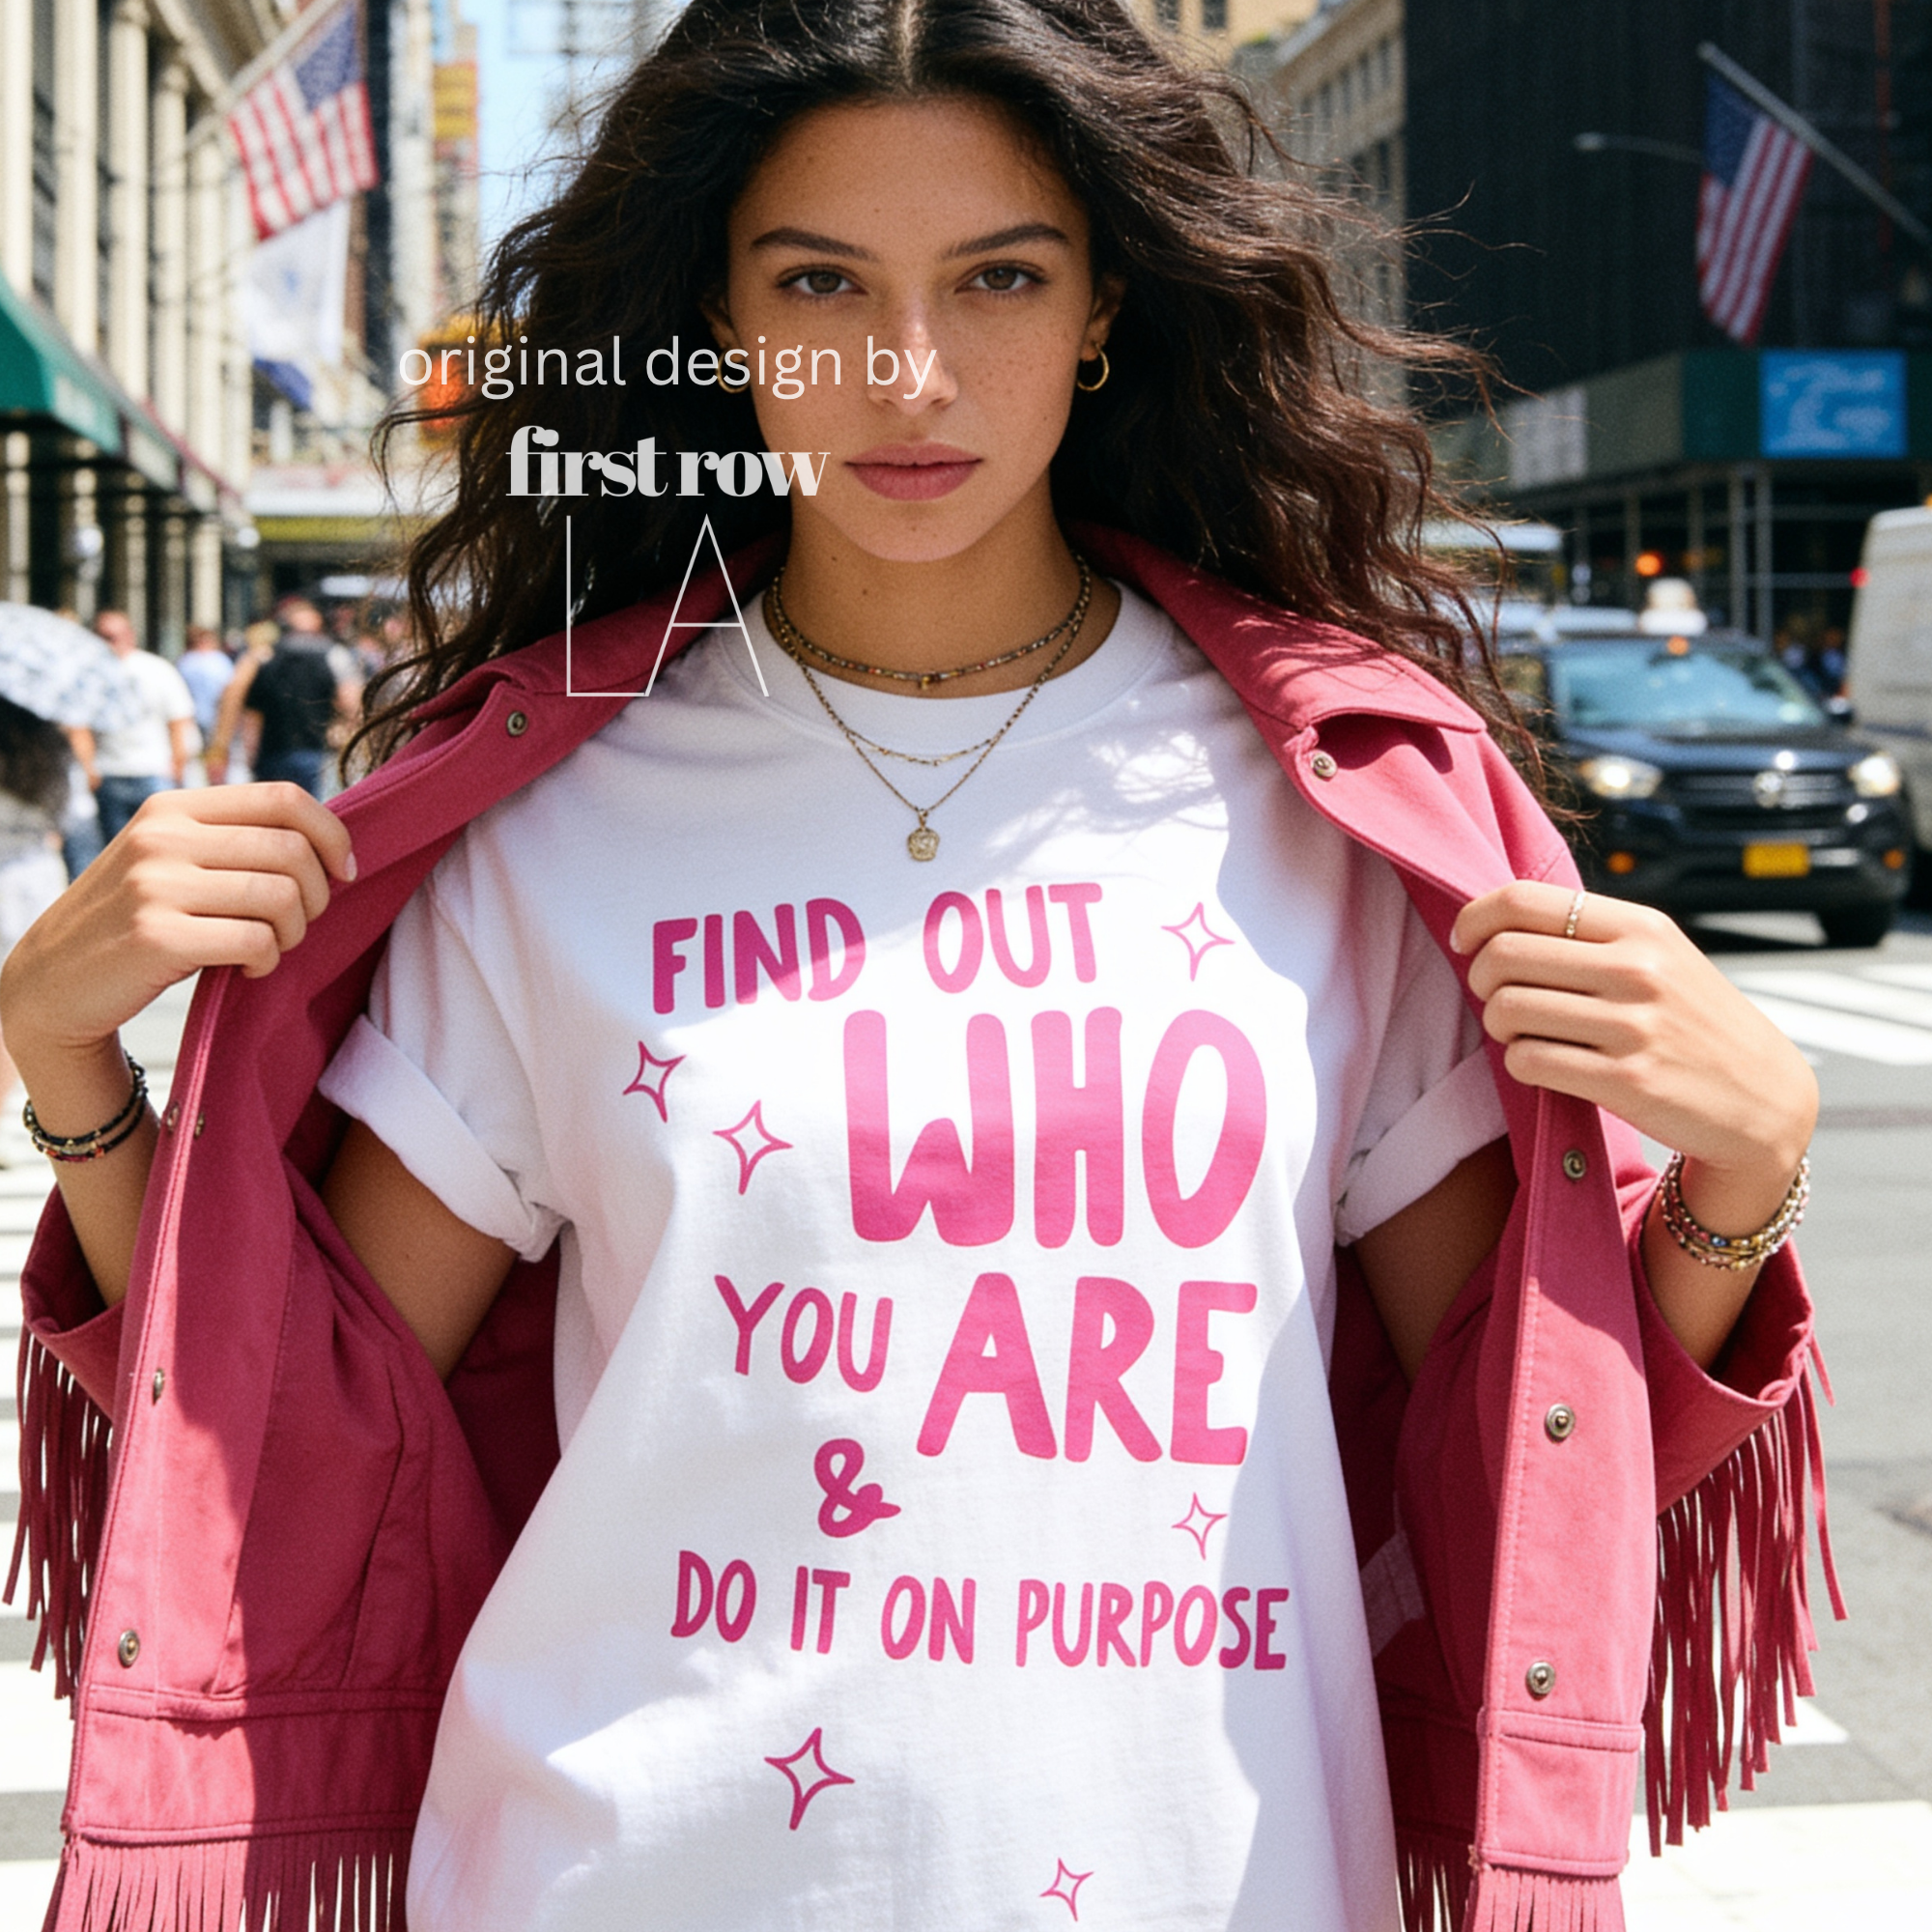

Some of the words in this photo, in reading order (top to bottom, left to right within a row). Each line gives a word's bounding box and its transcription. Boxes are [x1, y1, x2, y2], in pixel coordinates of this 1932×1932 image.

[652, 897, 867, 1014] FIND
[923, 883, 1103, 994] OUT
[843, 1007, 1268, 1249] WHO
[714, 1274, 894, 1394] YOU
[916, 1271, 1258, 1466] ARE
[813, 1437, 901, 1539] &
[670, 1549, 757, 1643] DO
[790, 1565, 851, 1655] IT
[880, 1575, 977, 1665] ON
[1015, 1578, 1290, 1671] PURPOSE
